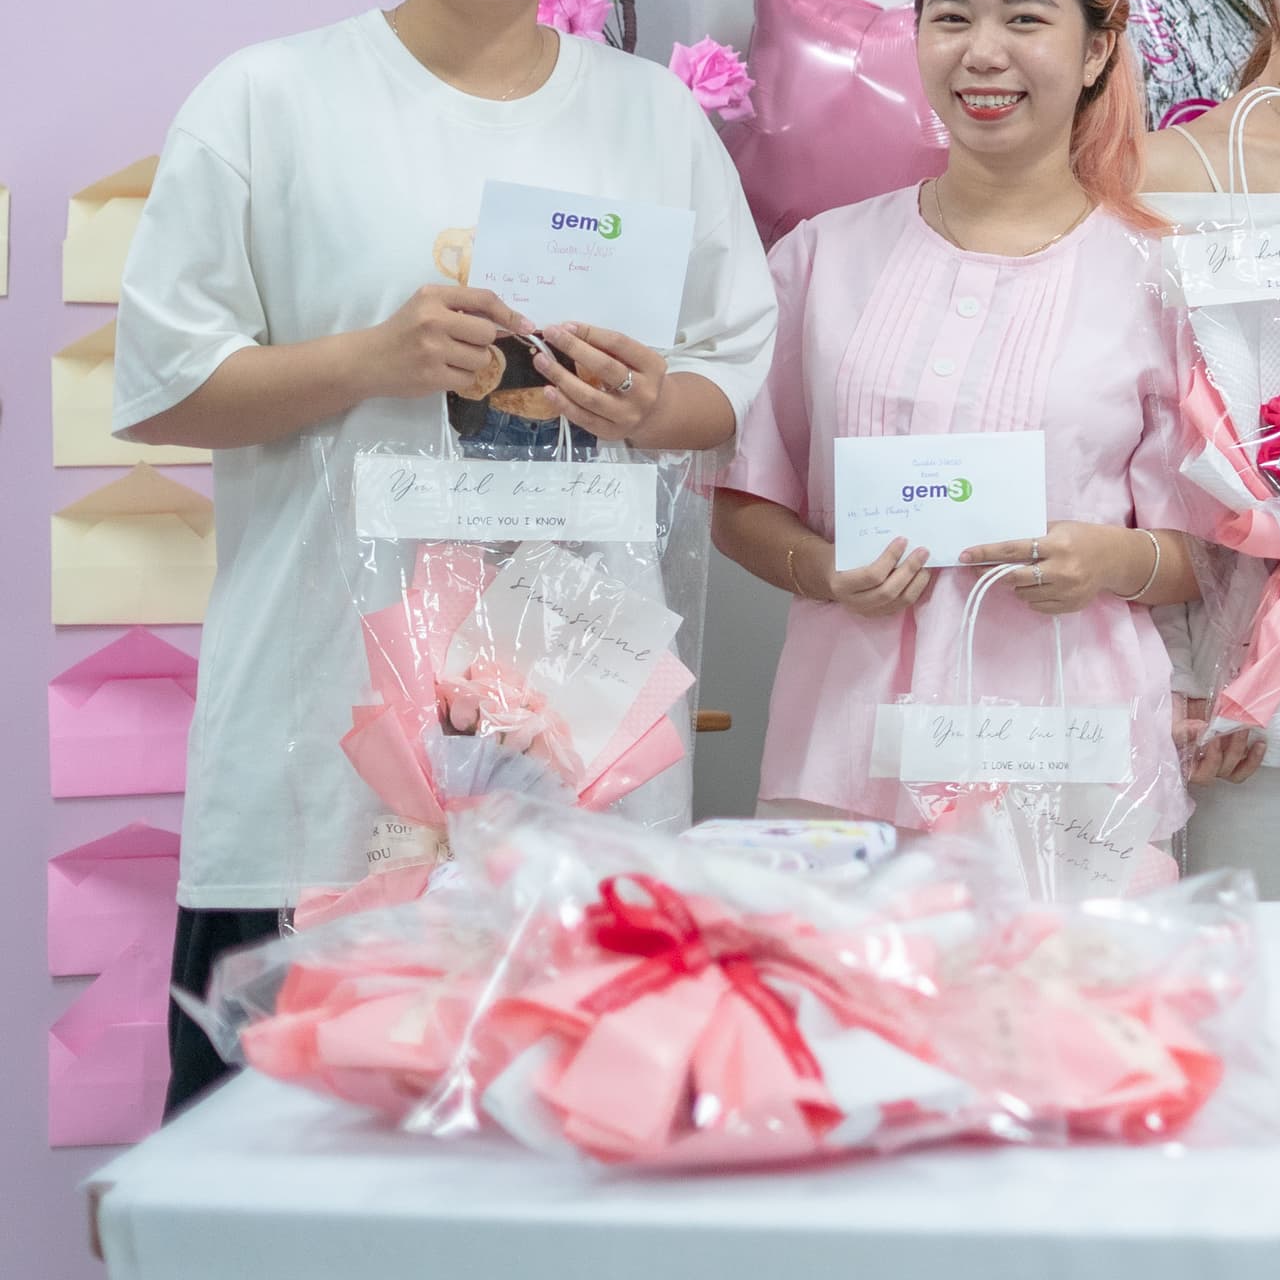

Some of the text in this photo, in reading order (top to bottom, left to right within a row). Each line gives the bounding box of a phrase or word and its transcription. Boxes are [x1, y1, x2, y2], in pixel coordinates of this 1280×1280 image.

[467, 516, 493, 526] LOVE
[498, 517, 519, 526] YOU
[535, 517, 567, 527] KNOW
[991, 761, 1013, 770] LOVE
[1018, 761, 1036, 770] YOU
[366, 847, 391, 863] YOU
